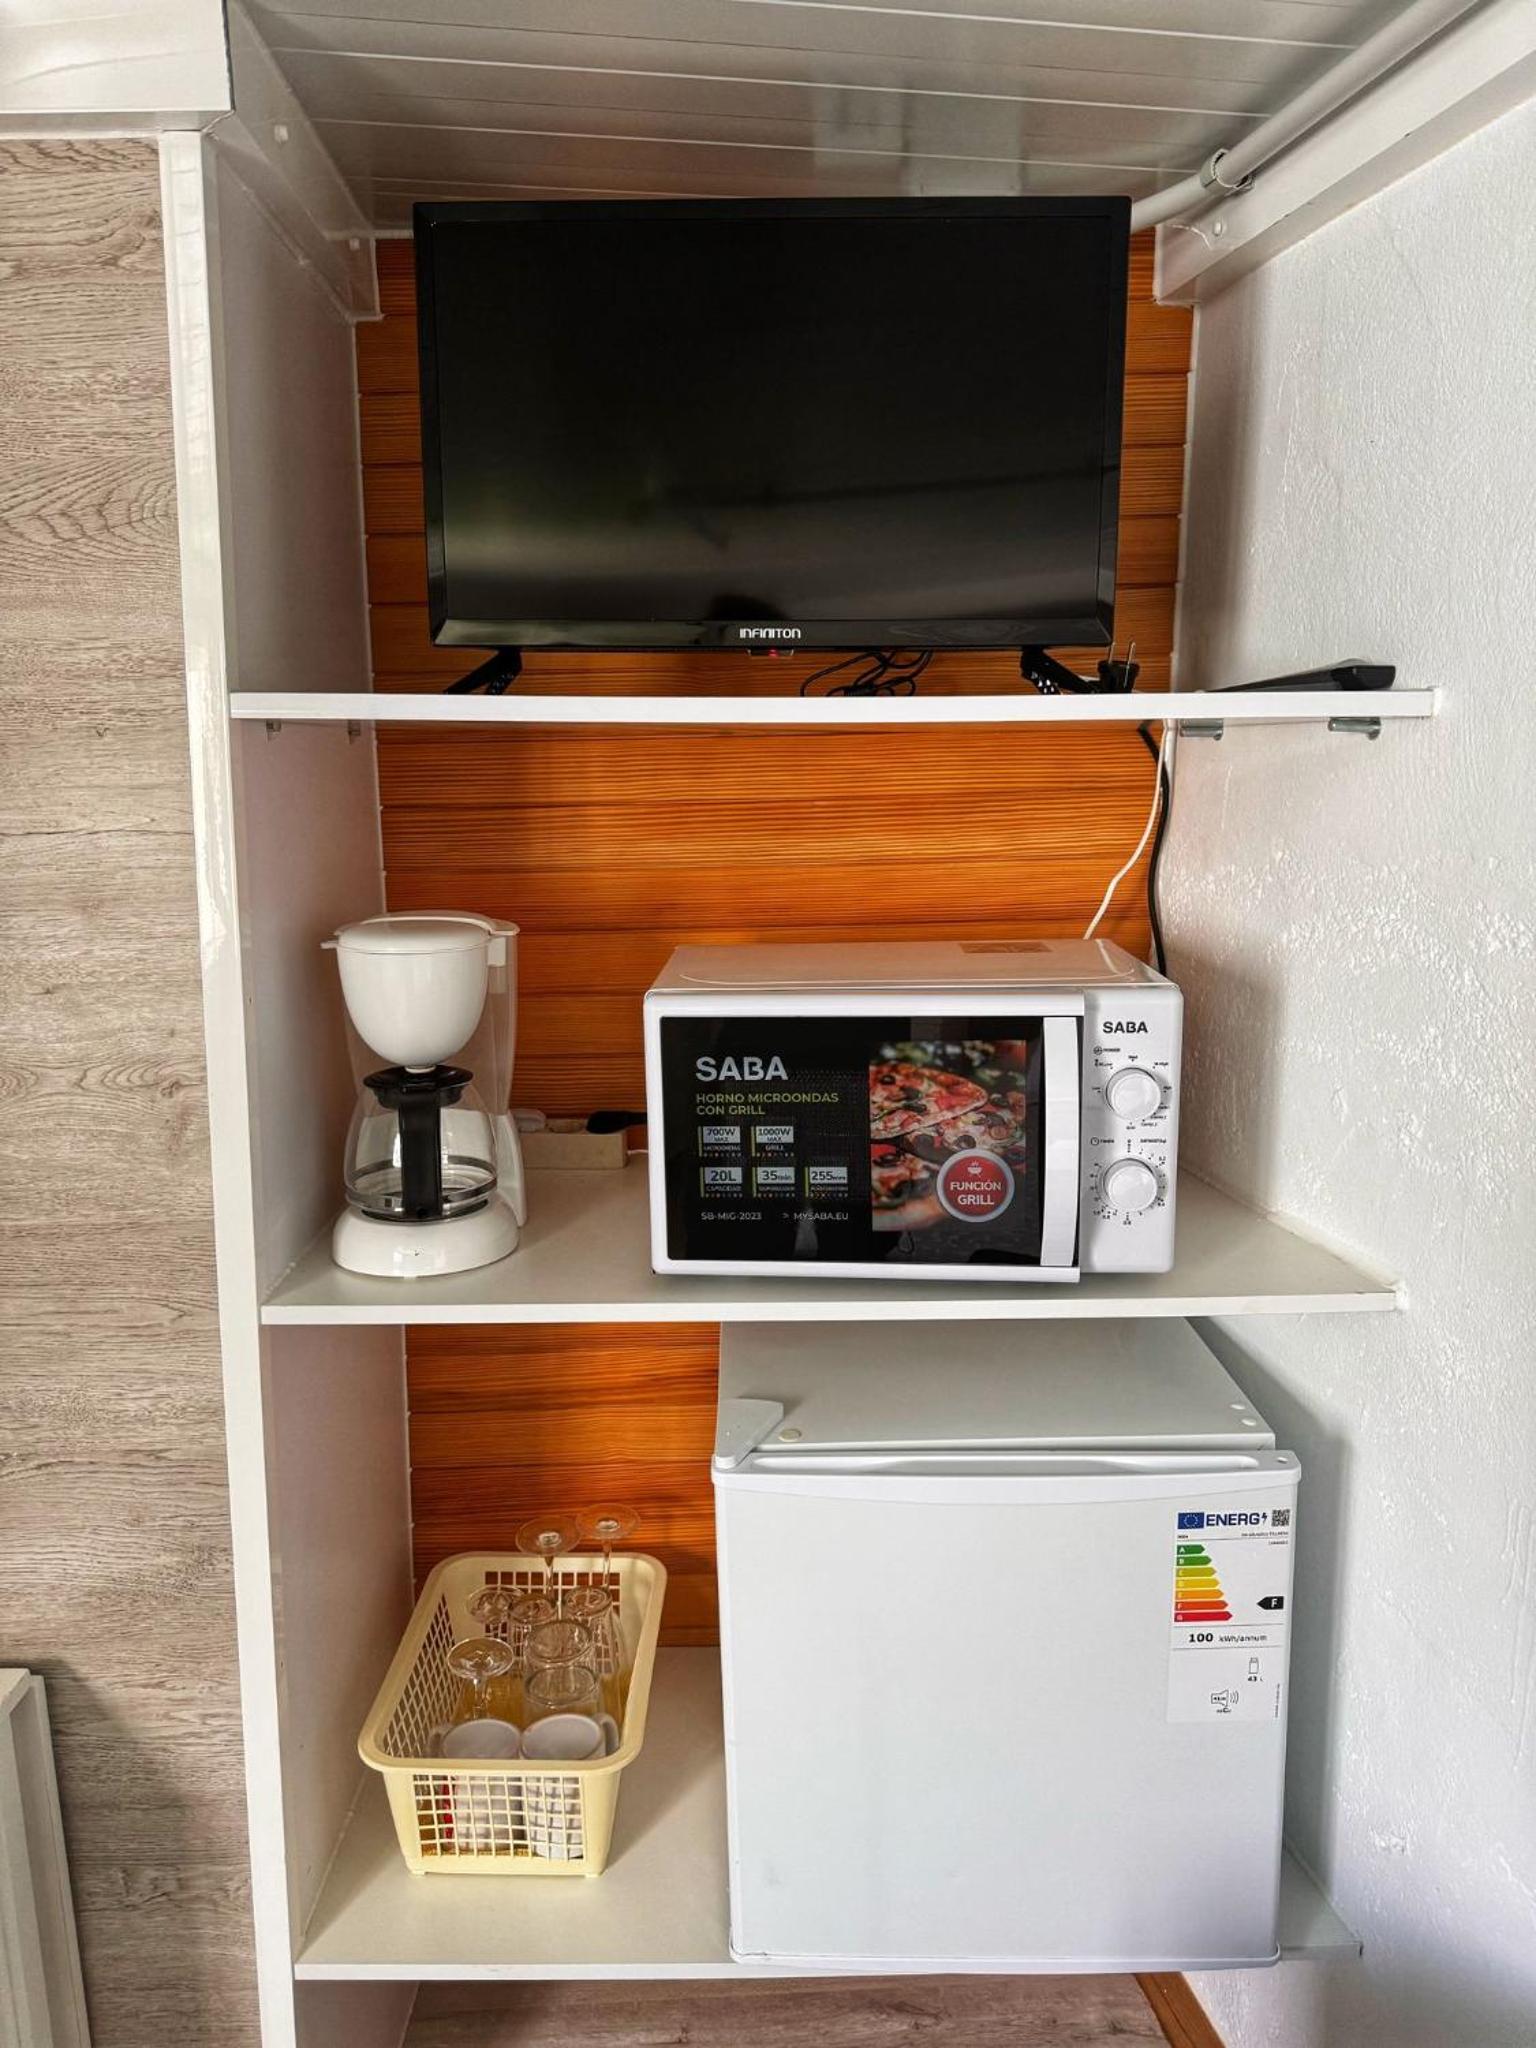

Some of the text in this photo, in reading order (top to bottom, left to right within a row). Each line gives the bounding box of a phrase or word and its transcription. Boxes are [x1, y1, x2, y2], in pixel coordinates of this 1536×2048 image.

[739, 627, 801, 639] INFINITON
[1102, 1021, 1148, 1034] SABA
[695, 1055, 789, 1082] SABA
[695, 1092, 839, 1103] HORNO MICROONDAS
[696, 1104, 766, 1115] CON GRILL
[706, 1127, 736, 1137] 700W
[758, 1127, 791, 1136] 1000W
[710, 1170, 737, 1182] 20L
[950, 1180, 1001, 1191] FUNCIÓN
[957, 1194, 995, 1206] GRILL
[793, 1211, 849, 1220] MYSABA.EU
[1271, 1598, 1278, 1609] F
[1188, 1632, 1214, 1643] 100
